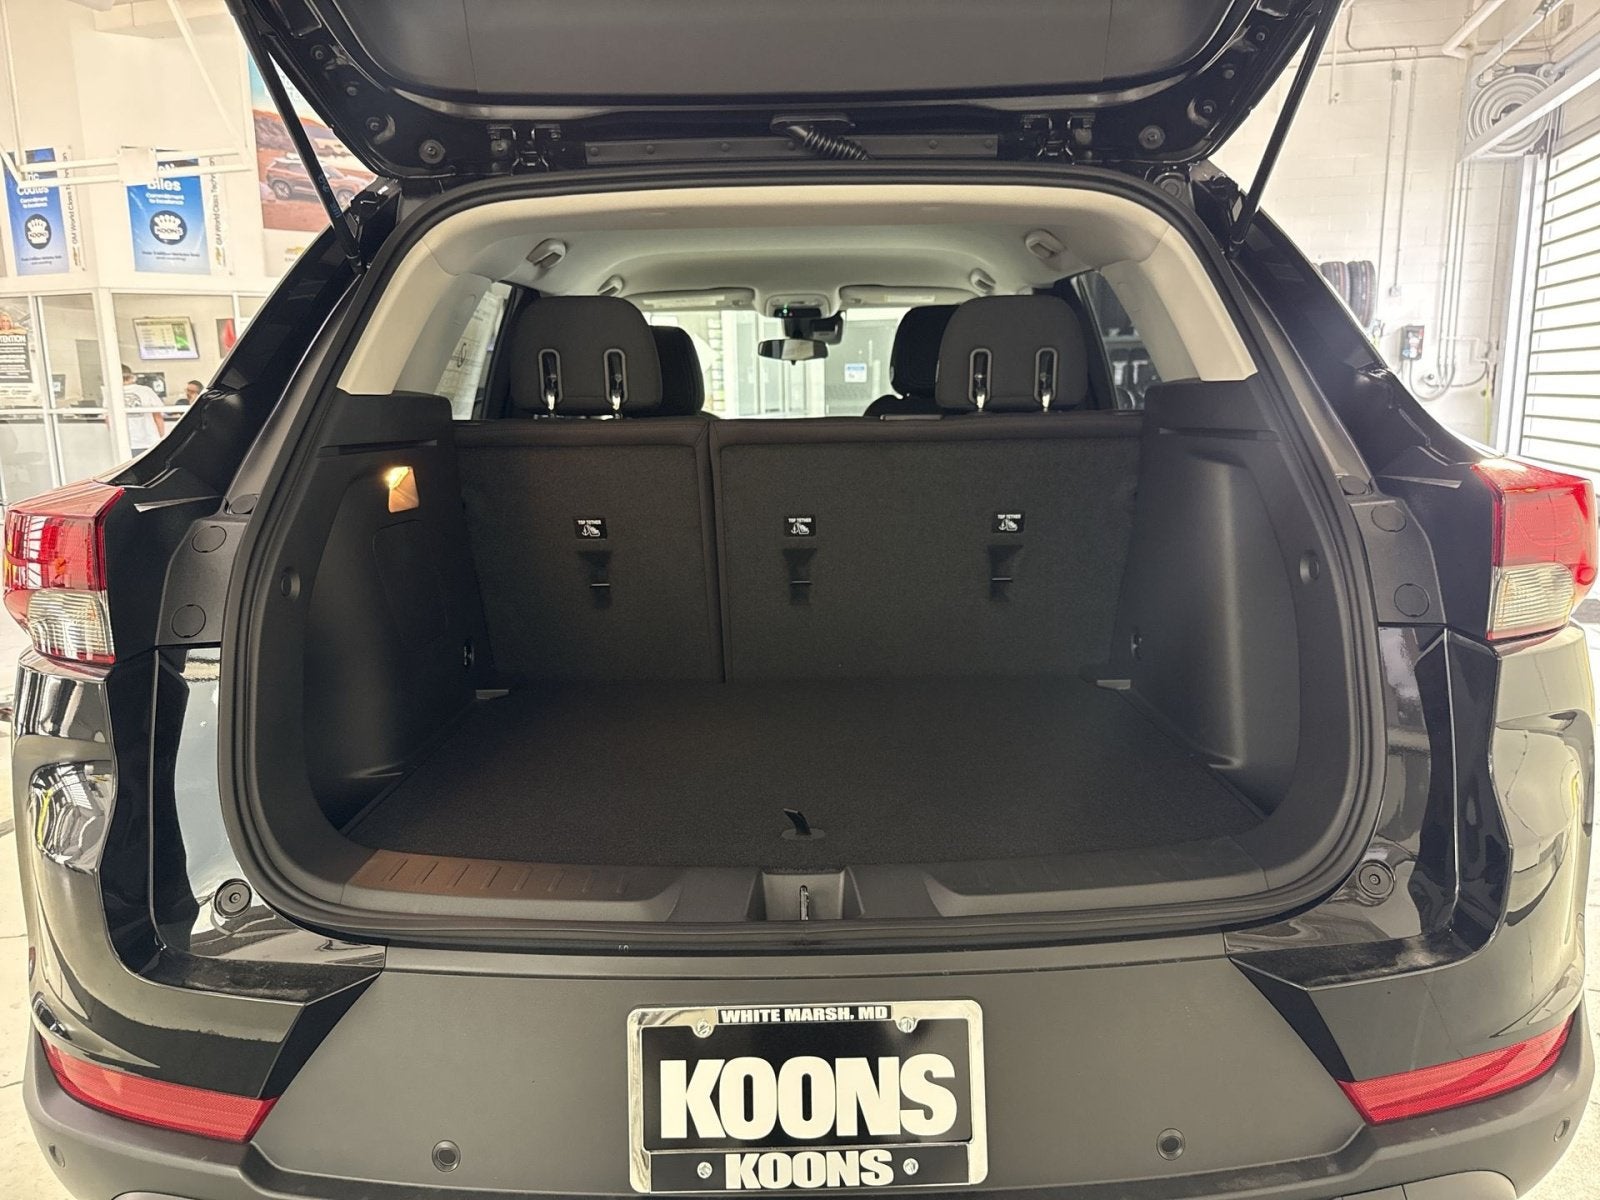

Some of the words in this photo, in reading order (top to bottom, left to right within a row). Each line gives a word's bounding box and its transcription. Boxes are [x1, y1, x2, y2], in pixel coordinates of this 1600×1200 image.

[720, 1009, 781, 1023] WHITE
[858, 1005, 888, 1020] MD
[660, 1053, 958, 1140] KOONS
[725, 1149, 895, 1190] KOONS
